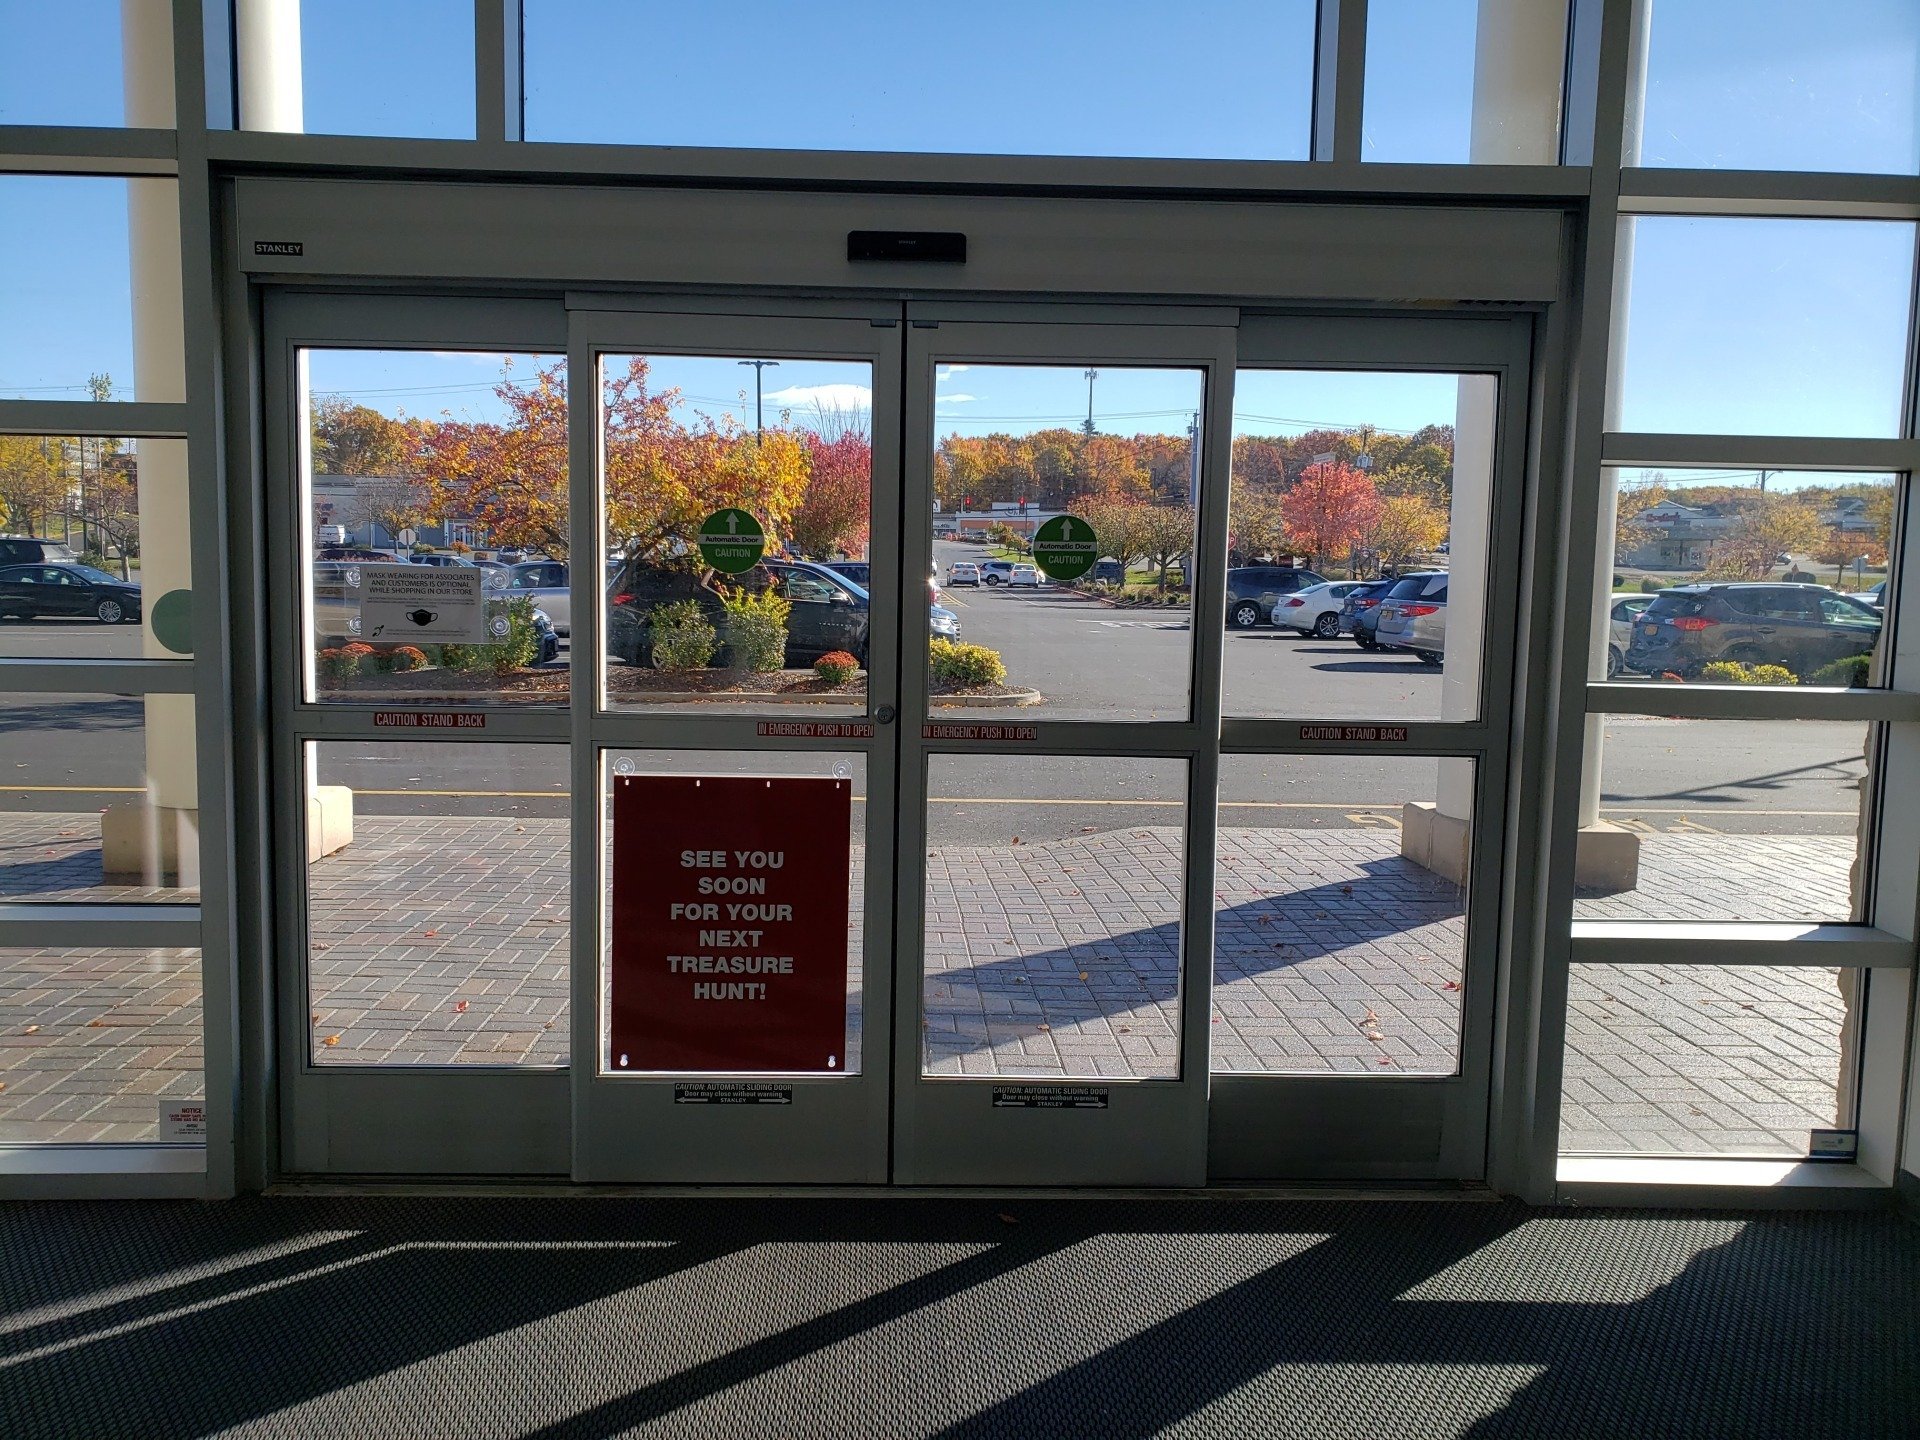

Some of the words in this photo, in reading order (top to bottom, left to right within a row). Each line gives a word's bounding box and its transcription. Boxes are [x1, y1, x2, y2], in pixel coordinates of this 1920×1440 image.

[256, 244, 300, 253] STANLEY
[715, 549, 750, 557] CAUTION
[1048, 556, 1084, 564] CAUTION
[377, 714, 417, 725] CAUTION
[422, 715, 453, 726] STAND
[458, 715, 482, 726] BACK
[758, 723, 766, 734] IN
[769, 723, 815, 735] EMERGENCY
[818, 724, 838, 736] PUSH
[841, 724, 850, 736] TO
[853, 725, 874, 736] OPEN
[923, 726, 931, 737] IN
[934, 726, 979, 738] EMERGENCY
[981, 726, 1002, 738] PUSH
[1004, 728, 1014, 738] TO
[1017, 728, 1037, 739] OPEN
[1302, 728, 1341, 739] CAUTION
[1346, 728, 1376, 739] STAND
[1381, 728, 1405, 740] BACK
[680, 850, 726, 868] SEE
[734, 851, 784, 868] YOU
[698, 877, 765, 894] SOON
[671, 903, 718, 920] FOR
[726, 904, 792, 921] YOUR
[700, 930, 763, 947] NEXT
[667, 956, 794, 974] TREASURE
[694, 983, 766, 1000] HUNT!
